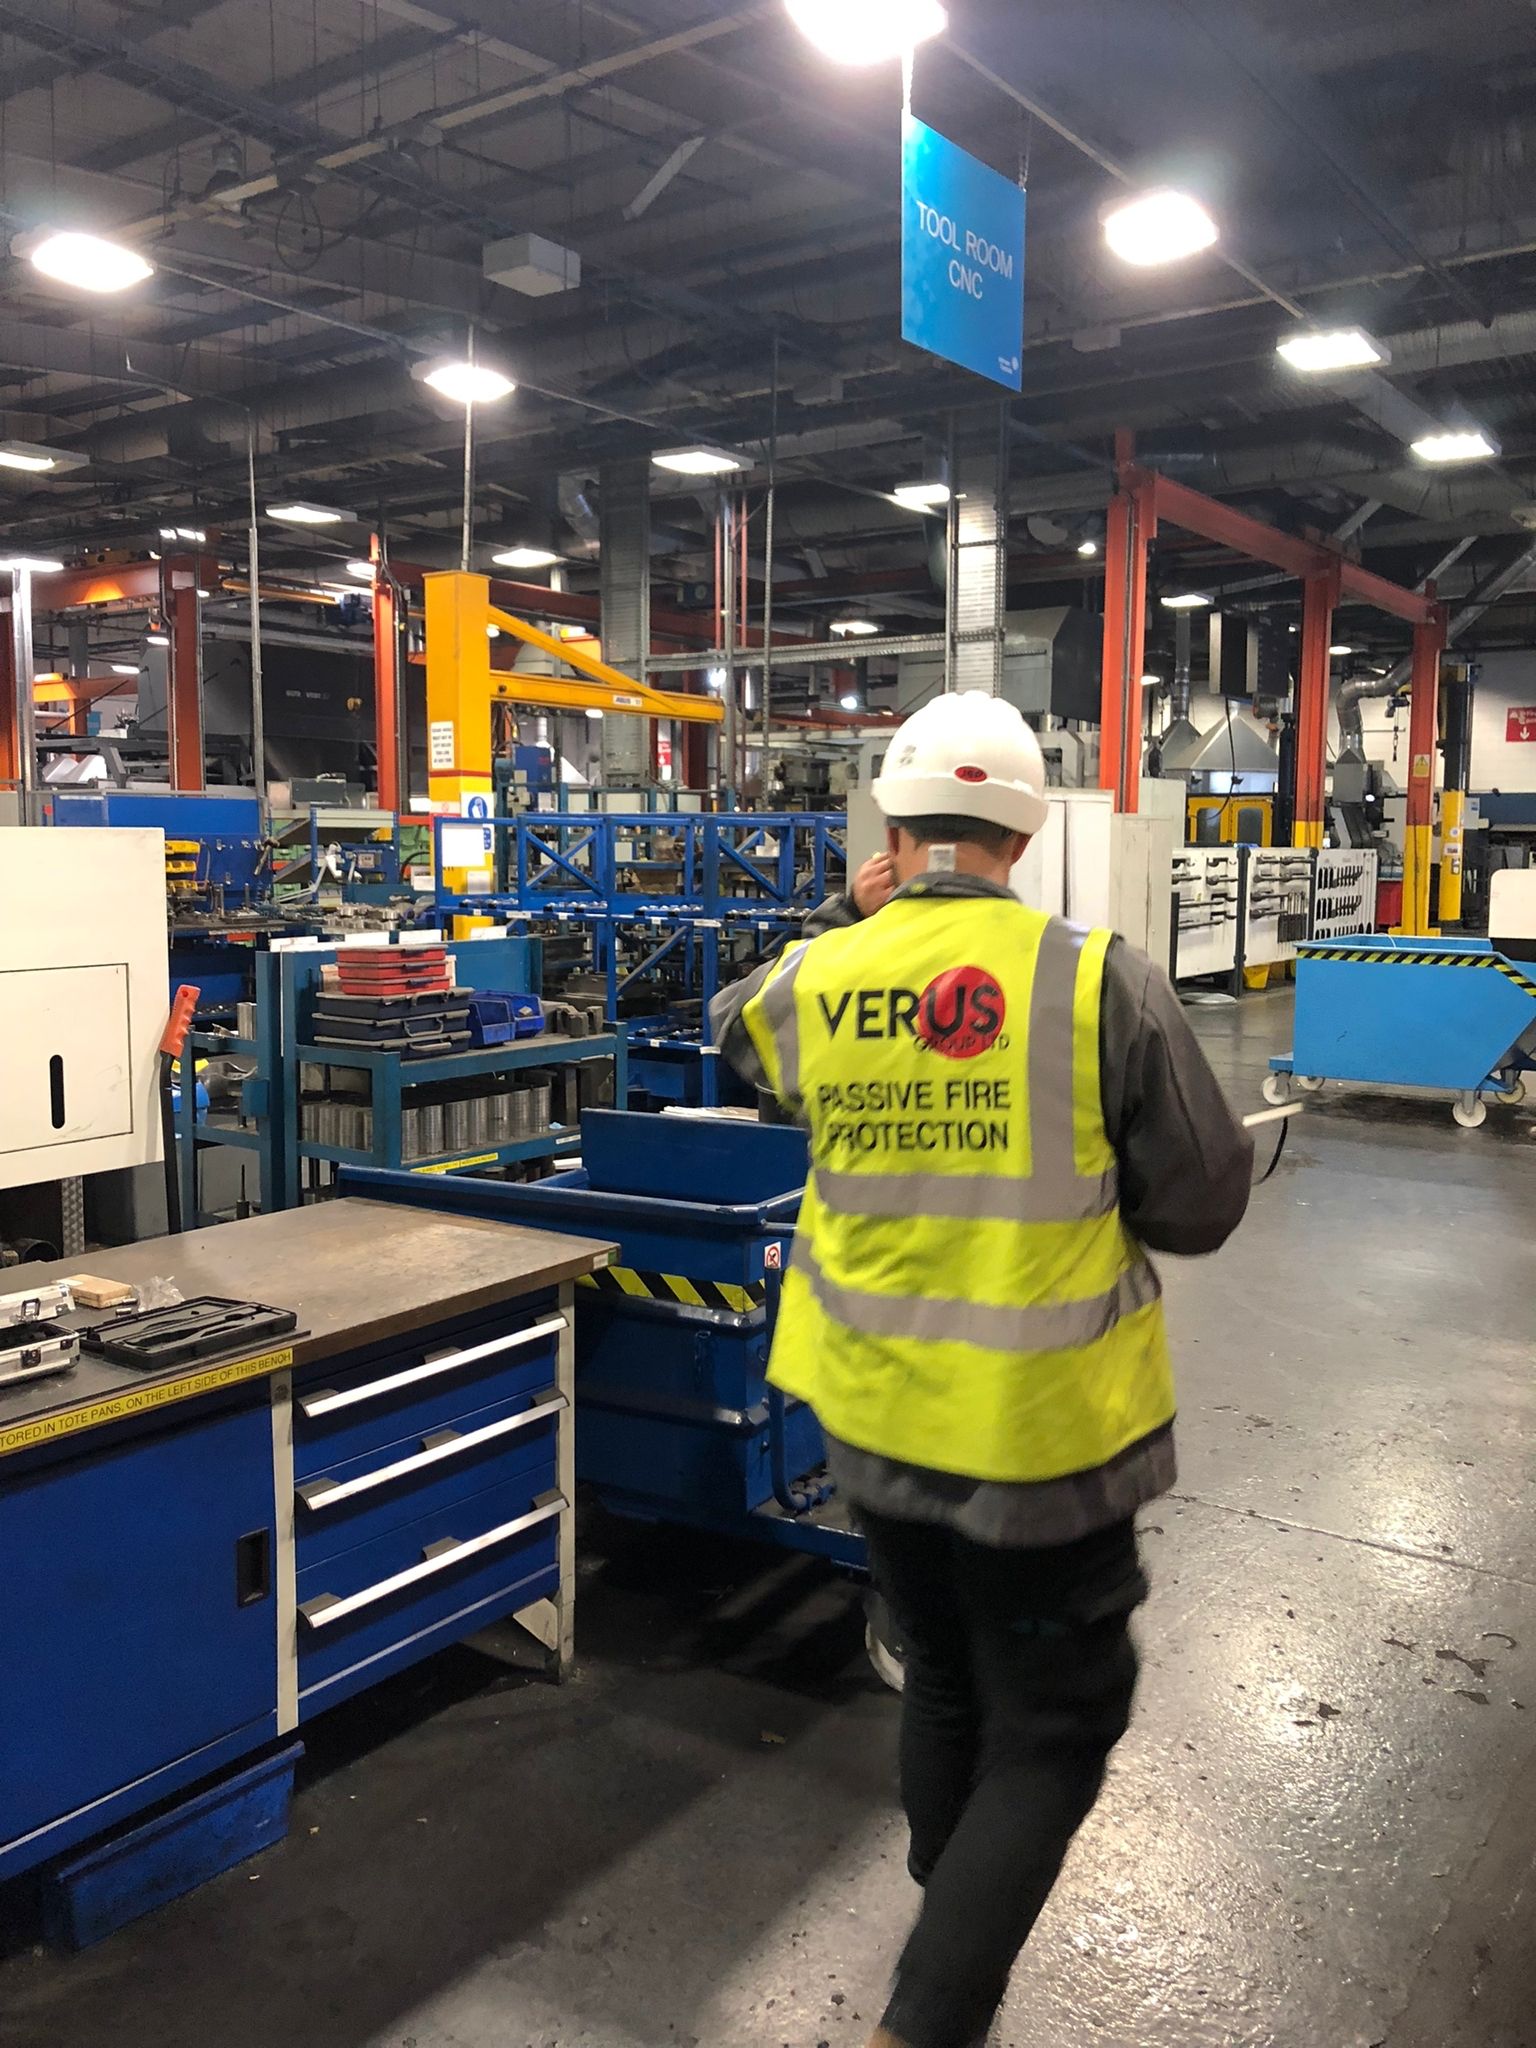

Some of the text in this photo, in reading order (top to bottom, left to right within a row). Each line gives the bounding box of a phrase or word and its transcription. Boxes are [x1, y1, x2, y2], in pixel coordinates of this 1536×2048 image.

[916, 200, 1012, 280] TOOL ROOM
[948, 259, 983, 299] CNC
[817, 984, 999, 1038] VERUS
[818, 1080, 1010, 1112] PASSIVE FIRE
[827, 1121, 1008, 1151] PROTECTION
[44, 1422, 56, 1434] IN
[57, 1414, 88, 1432] TOTE
[126, 1396, 143, 1410] ON
[144, 1389, 166, 1403] THE
[167, 1382, 193, 1397] LEFT
[194, 1375, 218, 1390] SIDE
[219, 1370, 235, 1381] OF
[235, 1362, 257, 1377] THIS
[258, 1352, 291, 1371] BENCH
